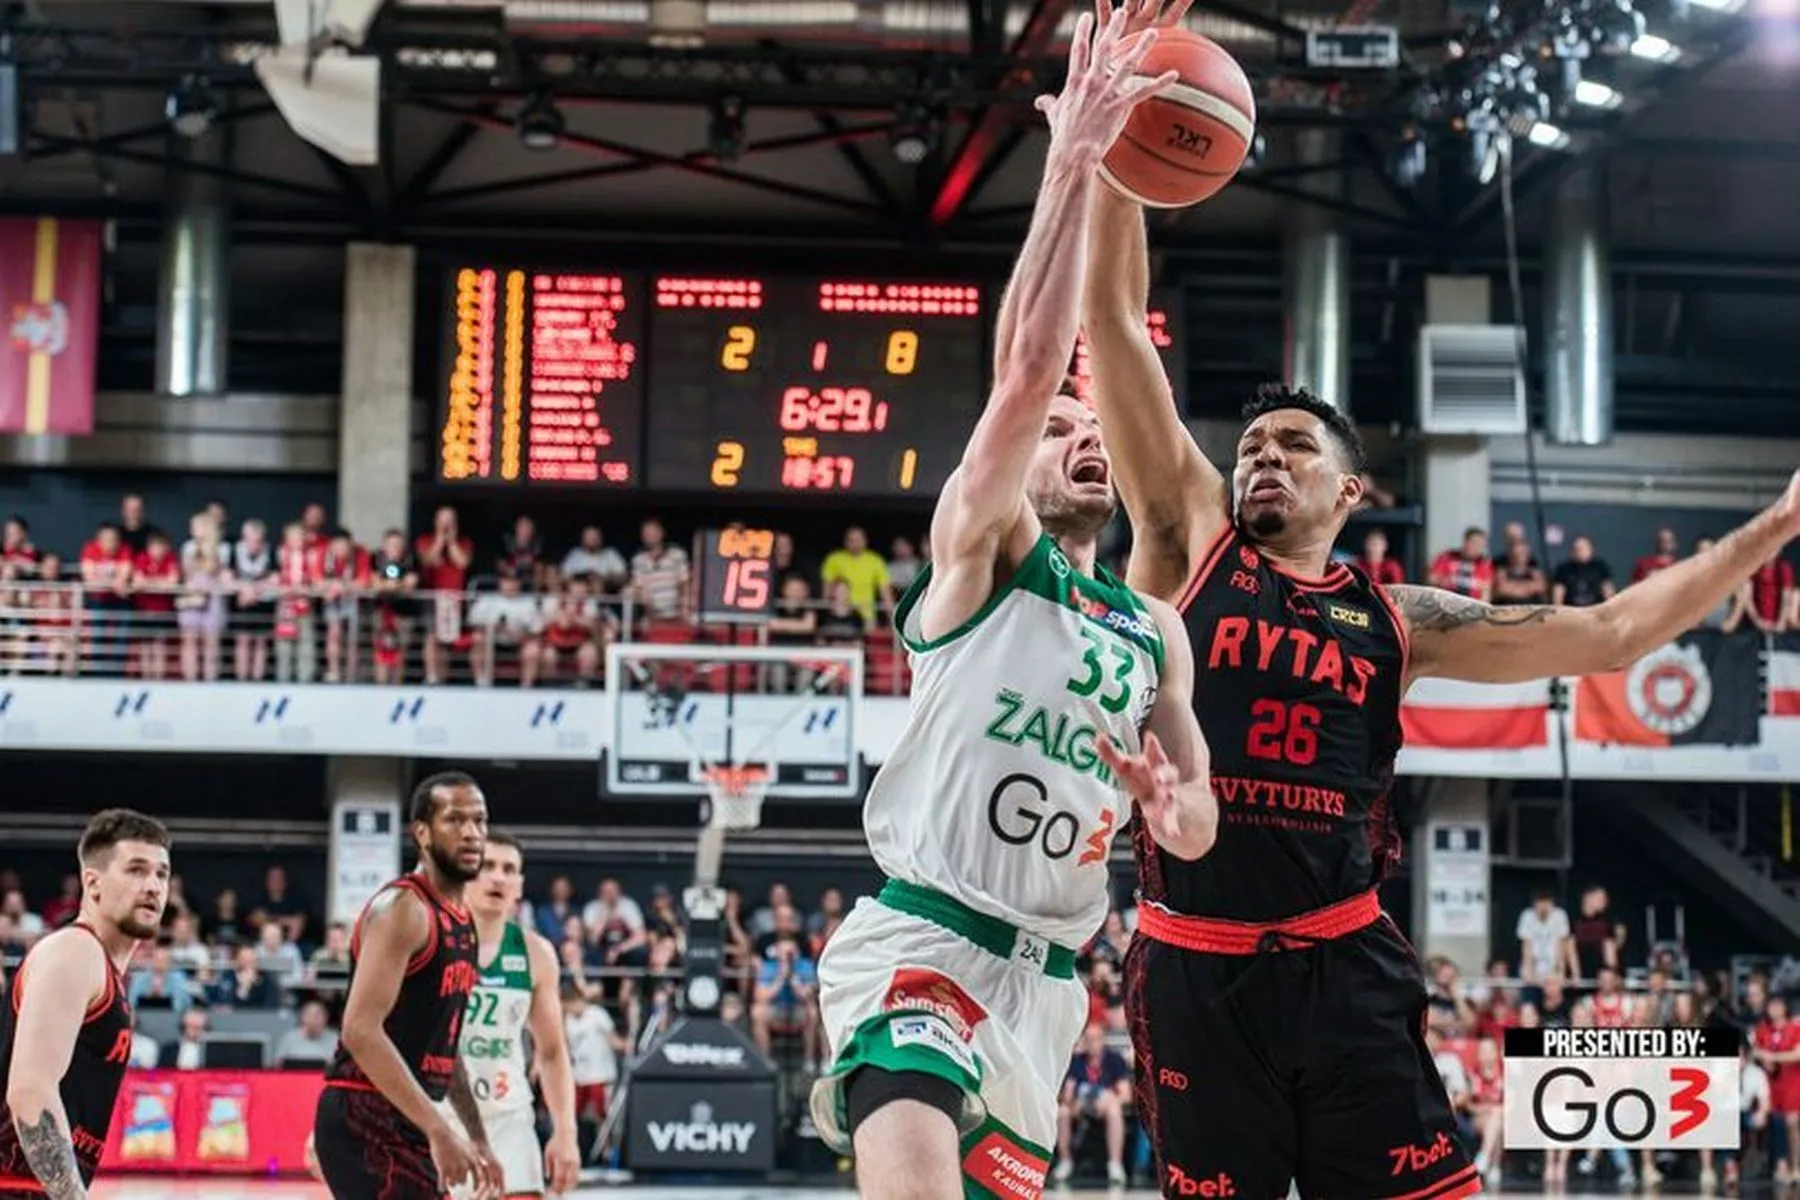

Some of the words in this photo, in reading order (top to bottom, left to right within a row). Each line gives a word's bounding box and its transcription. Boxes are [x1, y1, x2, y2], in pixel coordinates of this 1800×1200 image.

[722, 325, 756, 371] 2
[812, 340, 828, 371] 1
[885, 330, 919, 374] 8
[711, 441, 745, 487] 2
[901, 448, 917, 489] 1
[723, 559, 770, 609] 15
[1066, 625, 1135, 713] 33
[1208, 616, 1377, 706] RYTAS
[1246, 697, 1322, 766] 26
[988, 773, 1114, 866] Go3
[467, 991, 500, 1027] 92
[646, 1119, 757, 1153] VICHY
